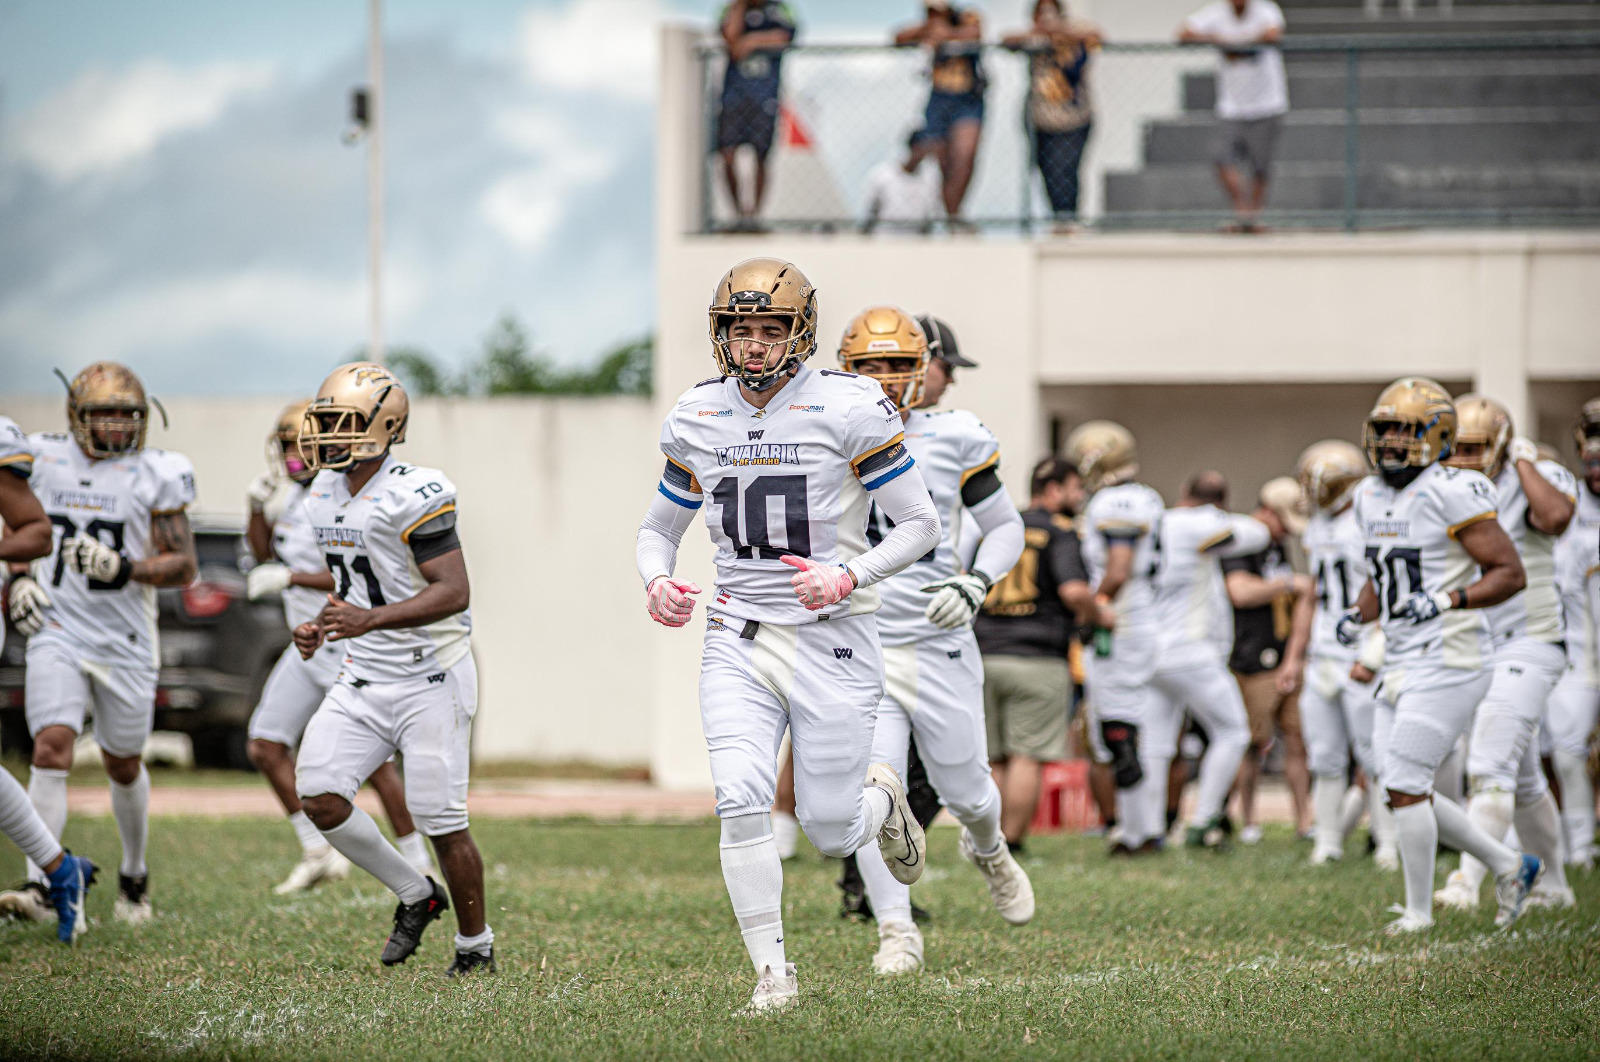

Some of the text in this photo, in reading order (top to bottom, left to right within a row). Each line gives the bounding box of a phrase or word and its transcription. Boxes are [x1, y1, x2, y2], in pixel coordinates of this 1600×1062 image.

[714, 443, 801, 467] CAVALARIA
[751, 457, 781, 466] JULHO
[414, 482, 443, 499] TD
[712, 475, 812, 560] 10
